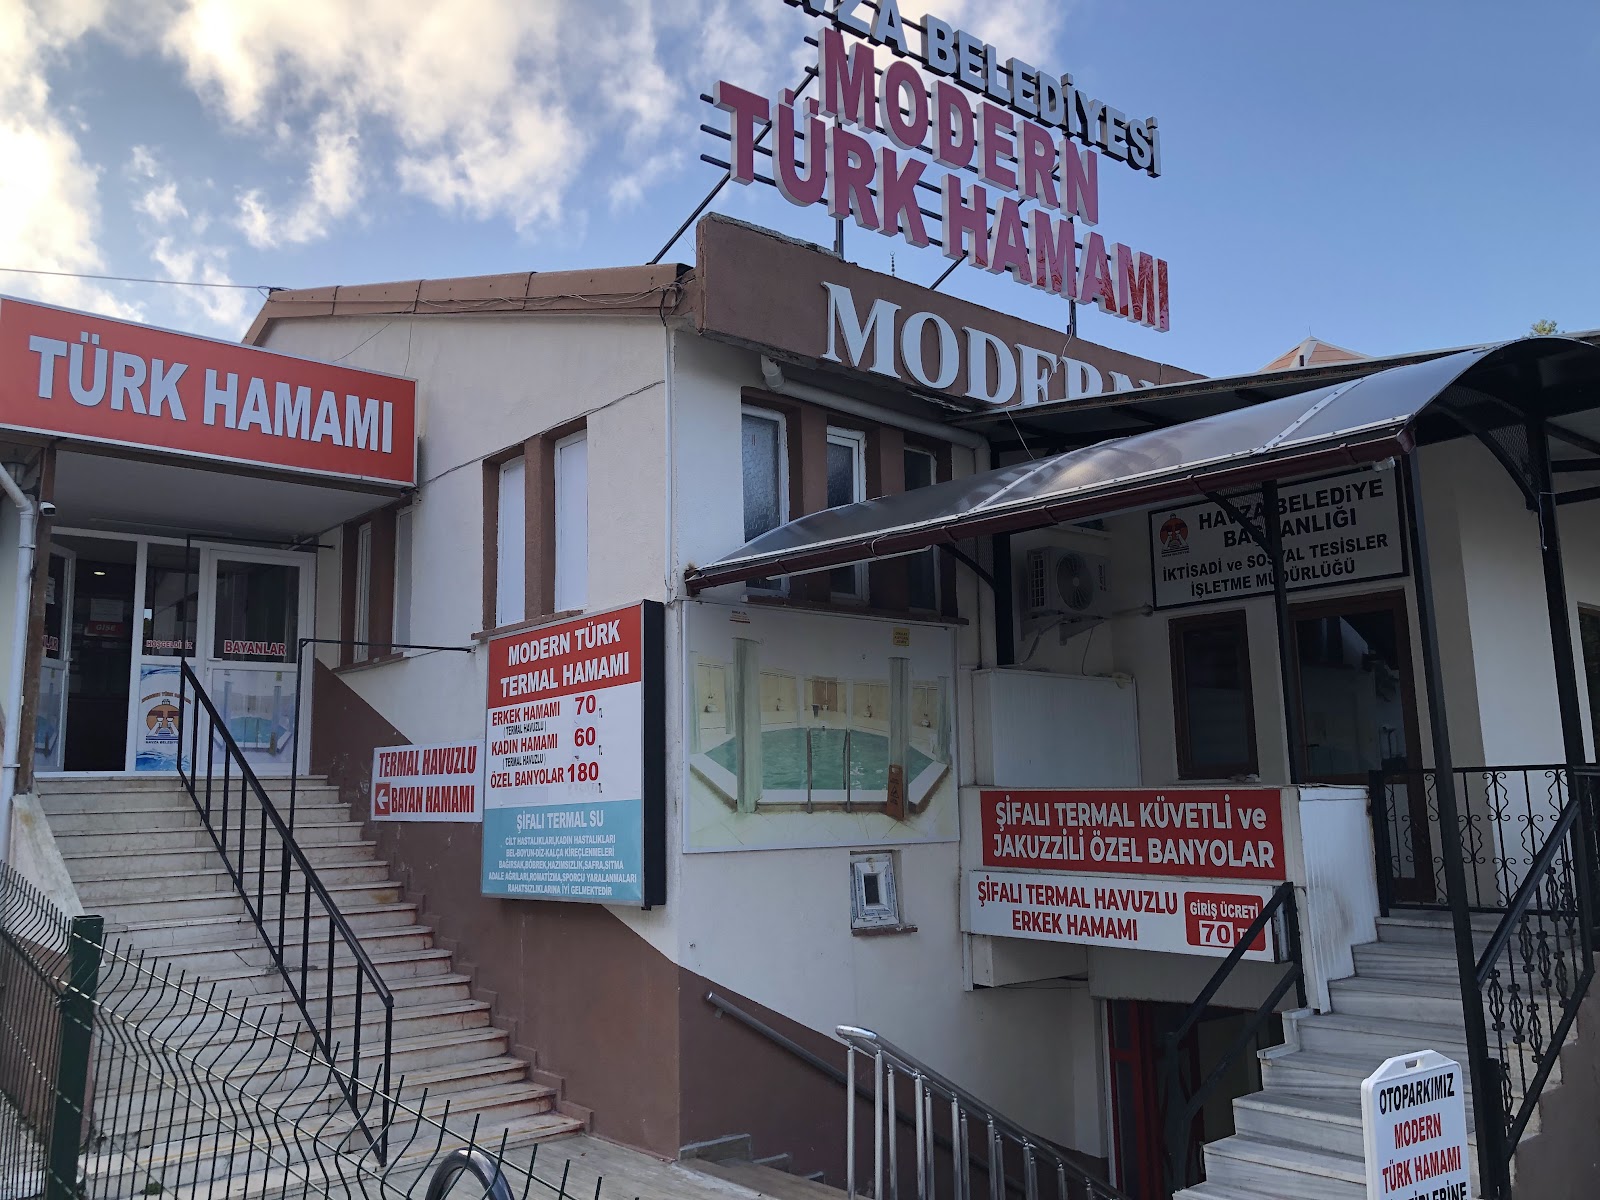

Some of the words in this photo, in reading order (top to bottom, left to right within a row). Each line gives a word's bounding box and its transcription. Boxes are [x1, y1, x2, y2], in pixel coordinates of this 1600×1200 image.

[920, 14, 1161, 178] BELEDİYESİ
[818, 27, 1098, 226] MODERN
[713, 80, 929, 248] TÜRK
[941, 173, 1170, 333] HAMAMI
[29, 332, 188, 421] TÜRK
[203, 369, 393, 454] HAMAMI
[1163, 557, 1222, 581] İKTİSADİ
[1227, 561, 1242, 571] ve
[1312, 533, 1388, 560] TESİSLER
[1191, 581, 1252, 599] İŞLETME
[224, 640, 286, 655] BAYANLAR
[508, 631, 571, 667] MODERN
[575, 619, 620, 651] TÜRK
[500, 667, 558, 698] TERMAL
[562, 651, 629, 687] HAMAMI
[492, 708, 521, 727] ERKEK
[523, 701, 560, 724] HAMAMI
[575, 694, 596, 716] 70
[491, 739, 519, 756] KADIN
[520, 734, 558, 752] HAMAMI
[574, 727, 596, 747] 60
[379, 750, 421, 777] TERMAL
[422, 746, 477, 776] HAVUZLU
[490, 770, 512, 788] ÖZEL
[514, 767, 565, 787] BANYOLAR
[567, 761, 599, 783] 180
[391, 787, 423, 813] BAYAN
[425, 785, 474, 813] HAMAMI
[995, 794, 1050, 831] ŞİFALI
[1054, 802, 1135, 829] TERMAL
[1139, 794, 1232, 829] KÜVETLİ
[1237, 807, 1267, 829] ve
[516, 811, 545, 833] ŞİFALI
[547, 811, 587, 829] TERMAL
[589, 810, 604, 827] SU
[505, 835, 517, 846] CİLT
[573, 834, 616, 844] HASTALIKLARI
[564, 846, 615, 859] KİREÇLENMELERİ
[993, 828, 1085, 861] JAKUZZİLİ
[1090, 831, 1143, 863] ÖZEL
[1148, 839, 1275, 868] BANYOLAR
[488, 872, 504, 880] ADALE
[586, 873, 637, 884] YARALANMALARI
[507, 884, 561, 894] RAHATSIZLIKLARINA
[561, 884, 570, 895] İYİ
[570, 885, 613, 896] GELMEKTEDİR
[977, 875, 1023, 907] ŞİFALI
[1026, 883, 1092, 909] TERMAL
[1094, 888, 1178, 915] HAVUZLU
[1190, 899, 1218, 920] GİRİŞ
[1220, 901, 1258, 919] ÜCRETİ
[1012, 910, 1063, 934] ERKEK
[1066, 913, 1138, 941] HAMAMI
[1202, 924, 1230, 944] 70
[1379, 1073, 1455, 1115] OTOPARKIMIZ
[1394, 1113, 1441, 1149] MODERN
[1382, 1159, 1412, 1193] TÜRK
[1414, 1145, 1461, 1182] HAMAMI
